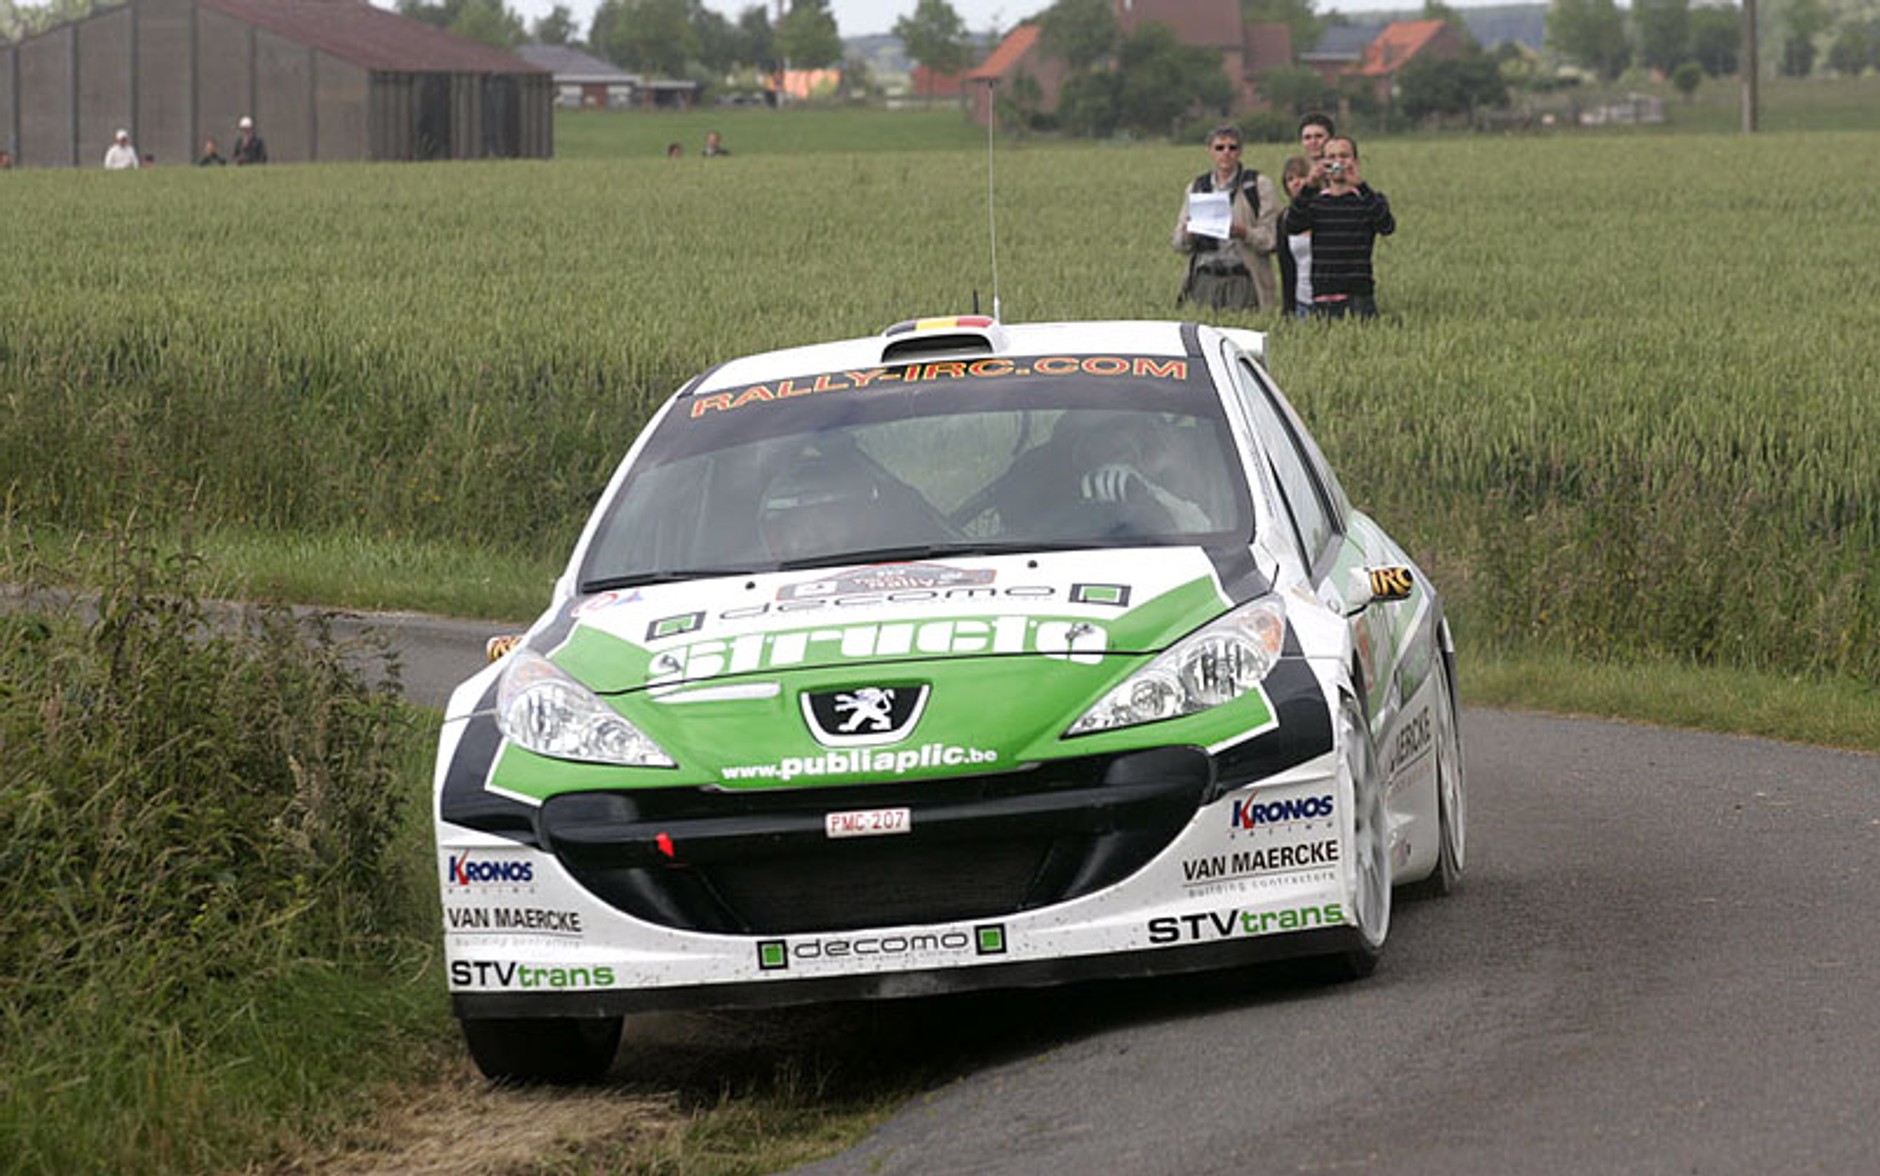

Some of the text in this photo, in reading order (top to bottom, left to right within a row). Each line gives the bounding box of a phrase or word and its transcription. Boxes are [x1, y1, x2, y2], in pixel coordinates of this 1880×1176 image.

[691, 357, 1189, 418] RALLY-IRC.COM
[1372, 567, 1413, 595] IRC
[721, 744, 997, 780] www.publiaplic.be
[1232, 791, 1334, 830] KRONOS
[449, 849, 533, 885] KRONOS
[1183, 840, 1340, 881] VAN MAERCKE
[448, 908, 582, 932] VAN MAERCKE
[1148, 903, 1344, 944] STVtrans
[794, 932, 968, 958] decomo
[451, 961, 615, 987] STVtrans
